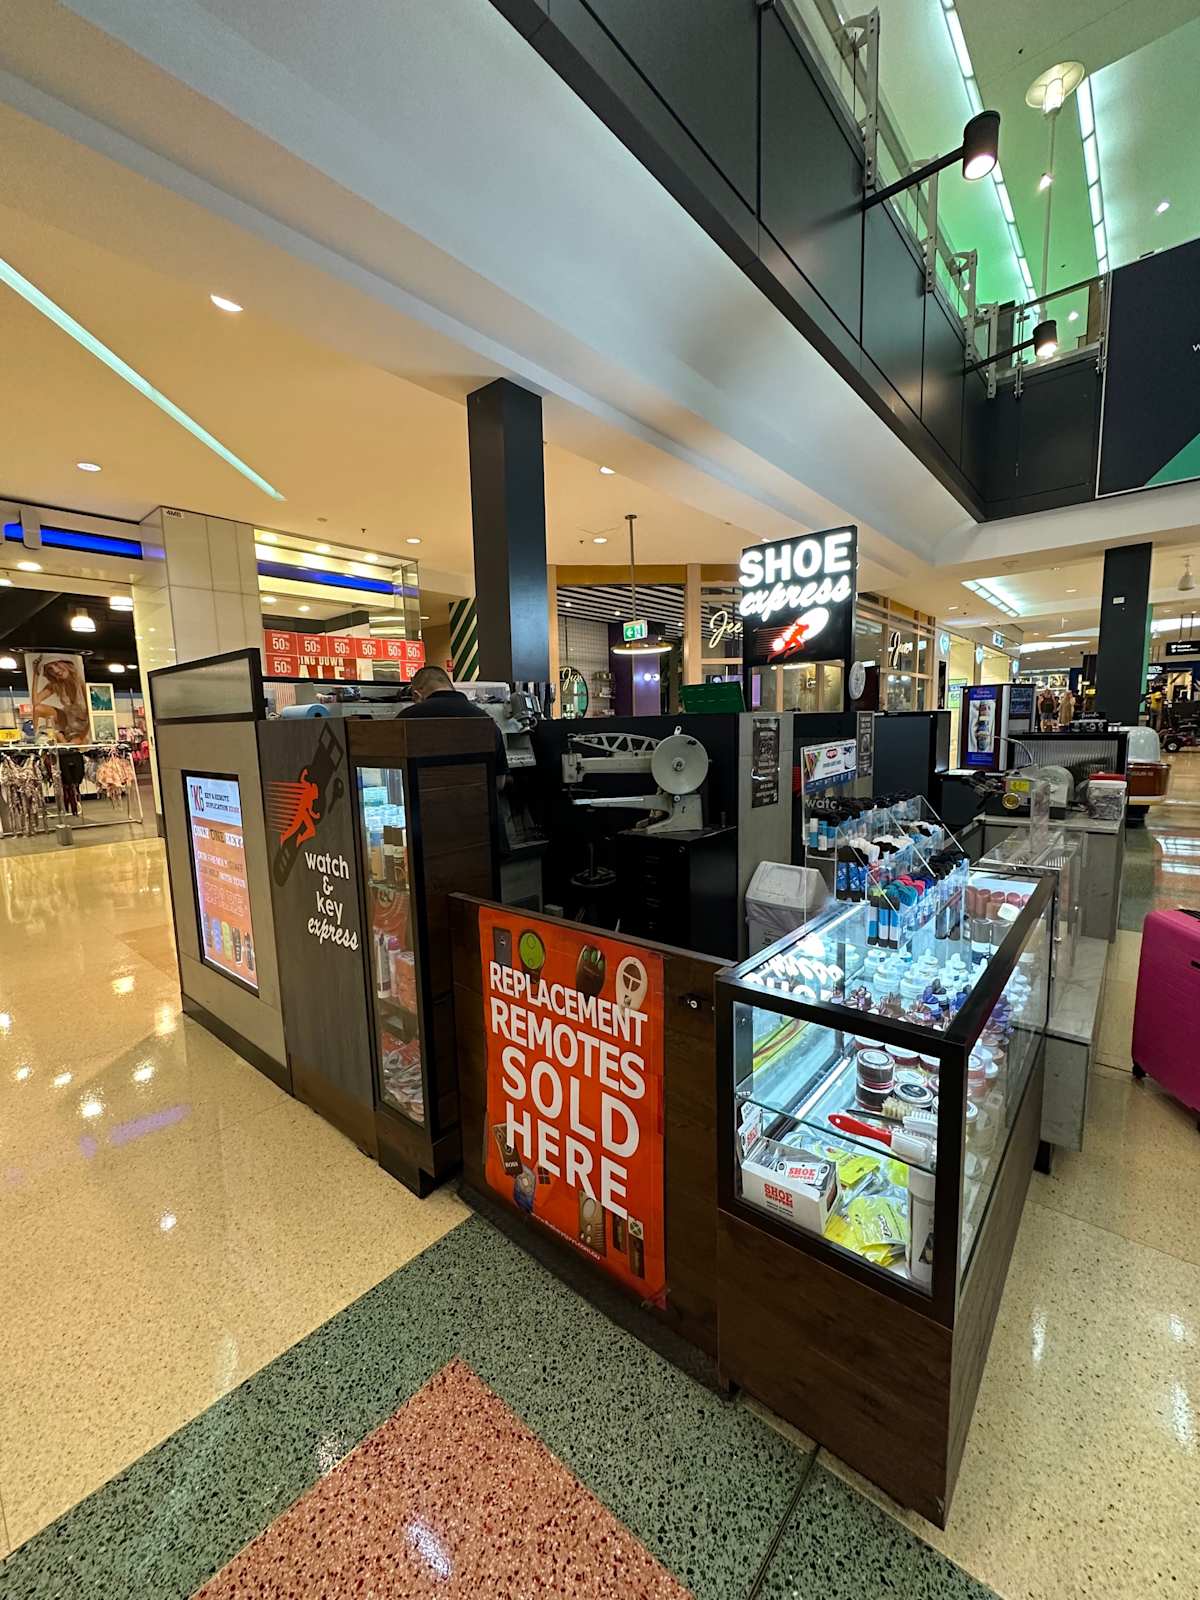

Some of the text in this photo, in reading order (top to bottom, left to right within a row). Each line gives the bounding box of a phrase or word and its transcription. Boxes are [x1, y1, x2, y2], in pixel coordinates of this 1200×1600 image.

[738, 531, 852, 588] SHOE
[738, 574, 852, 623] express
[304, 850, 350, 880] watch
[322, 874, 334, 896] &
[316, 890, 344, 925] key
[307, 916, 359, 951] express
[488, 960, 648, 1048] REPLACEMENT
[490, 996, 647, 1100] REMOTES
[500, 1046, 640, 1159] SOLD
[504, 1100, 629, 1221] HERE
[787, 1167, 817, 1177] SHOE
[764, 1183, 793, 1203] SHOE
